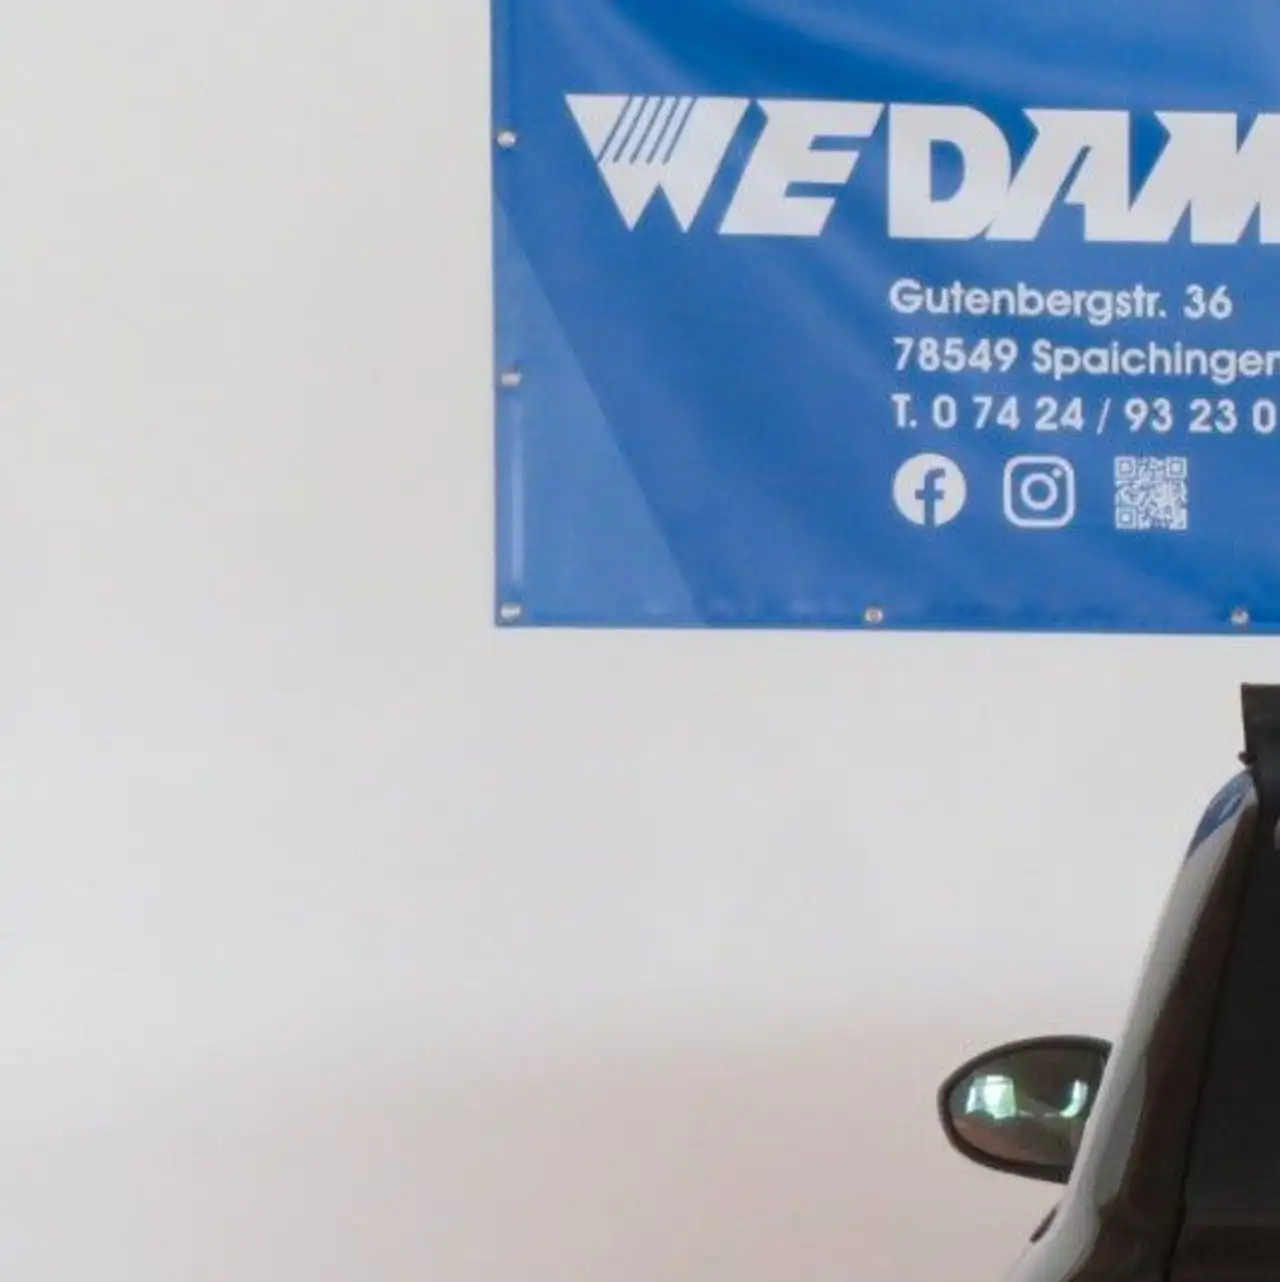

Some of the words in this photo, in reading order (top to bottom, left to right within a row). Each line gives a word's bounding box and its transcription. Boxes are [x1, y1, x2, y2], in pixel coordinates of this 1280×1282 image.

[889, 278, 1167, 326] Gutenbergstr.
[1183, 284, 1233, 320] 36
[893, 336, 1019, 373] 78549
[892, 394, 918, 429] T.
[932, 394, 957, 430] 0
[972, 396, 1020, 430] 74
[1034, 396, 1084, 431] 24
[1124, 398, 1173, 432] 93
[1188, 399, 1238, 433] 23
[1252, 398, 1278, 434] 0
